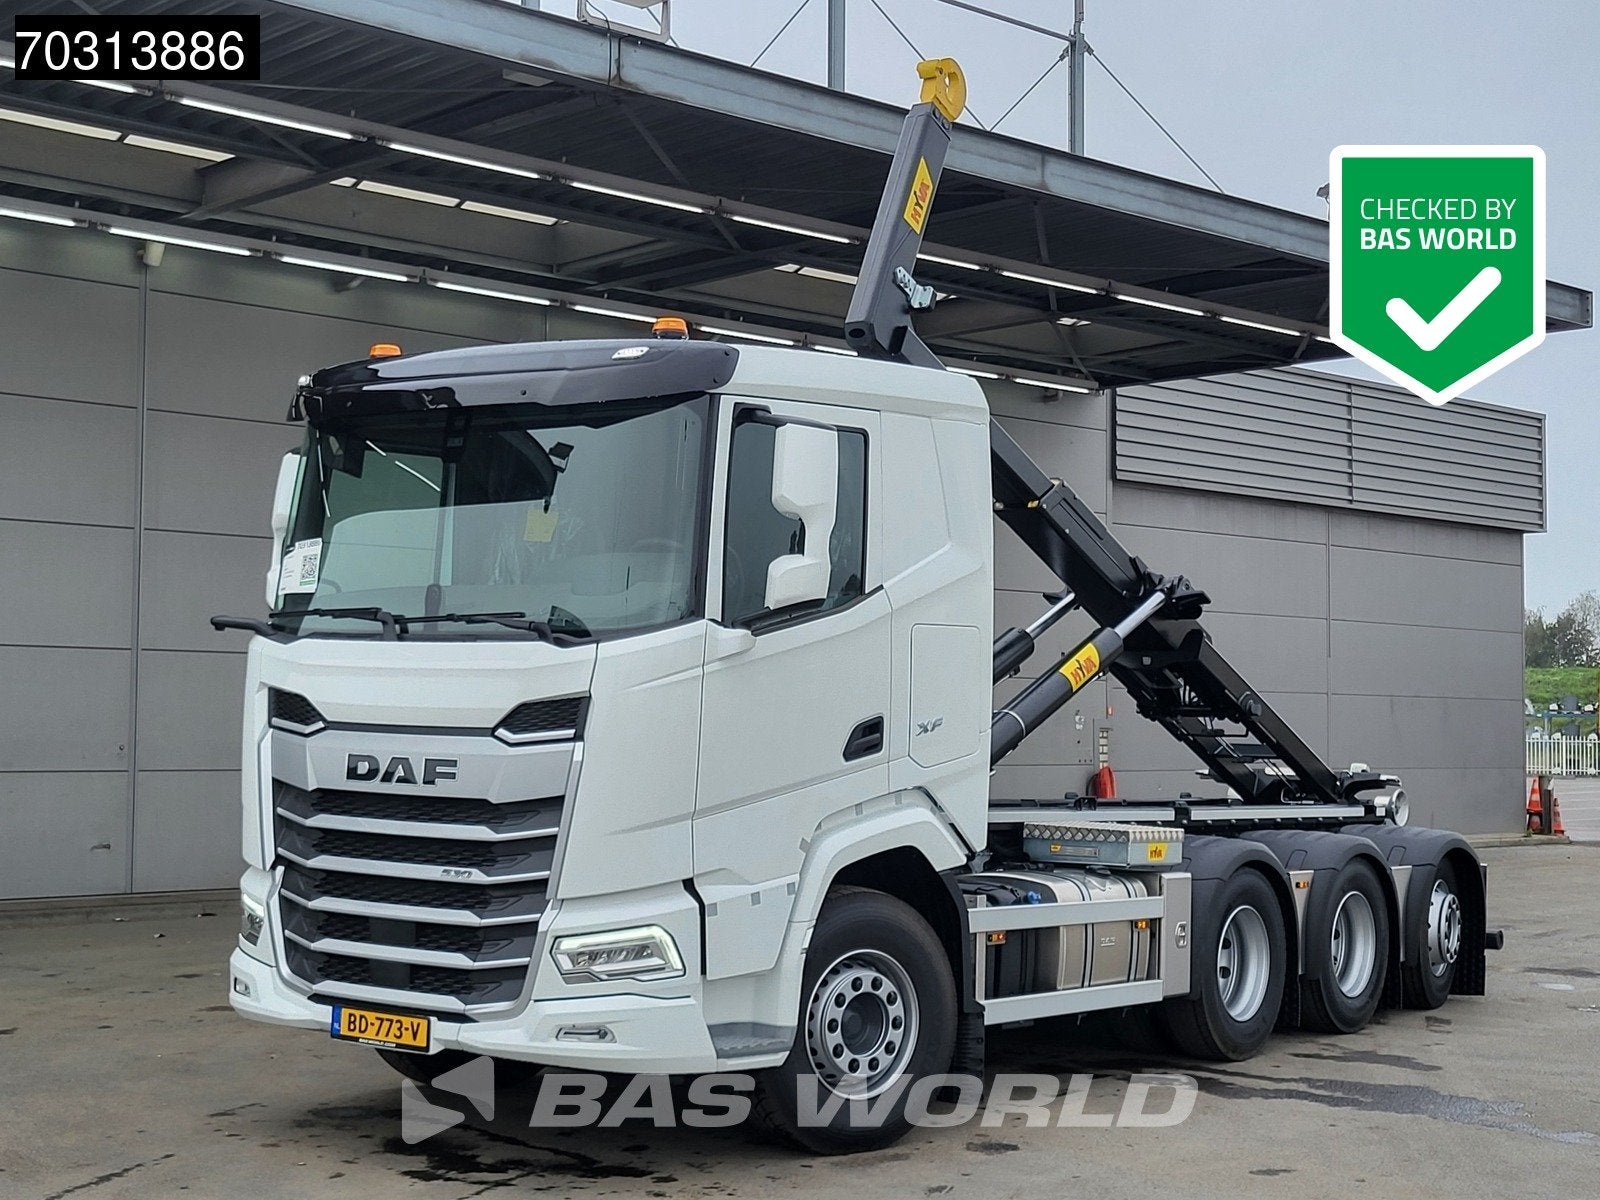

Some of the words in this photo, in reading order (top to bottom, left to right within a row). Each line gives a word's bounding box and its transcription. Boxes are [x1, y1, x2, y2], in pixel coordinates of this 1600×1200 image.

[911, 182, 930, 225] HYVA
[1070, 656, 1097, 685] HYVA
[916, 716, 944, 737] XF
[346, 753, 458, 785] DAF
[347, 1012, 421, 1042] BD-773-V
